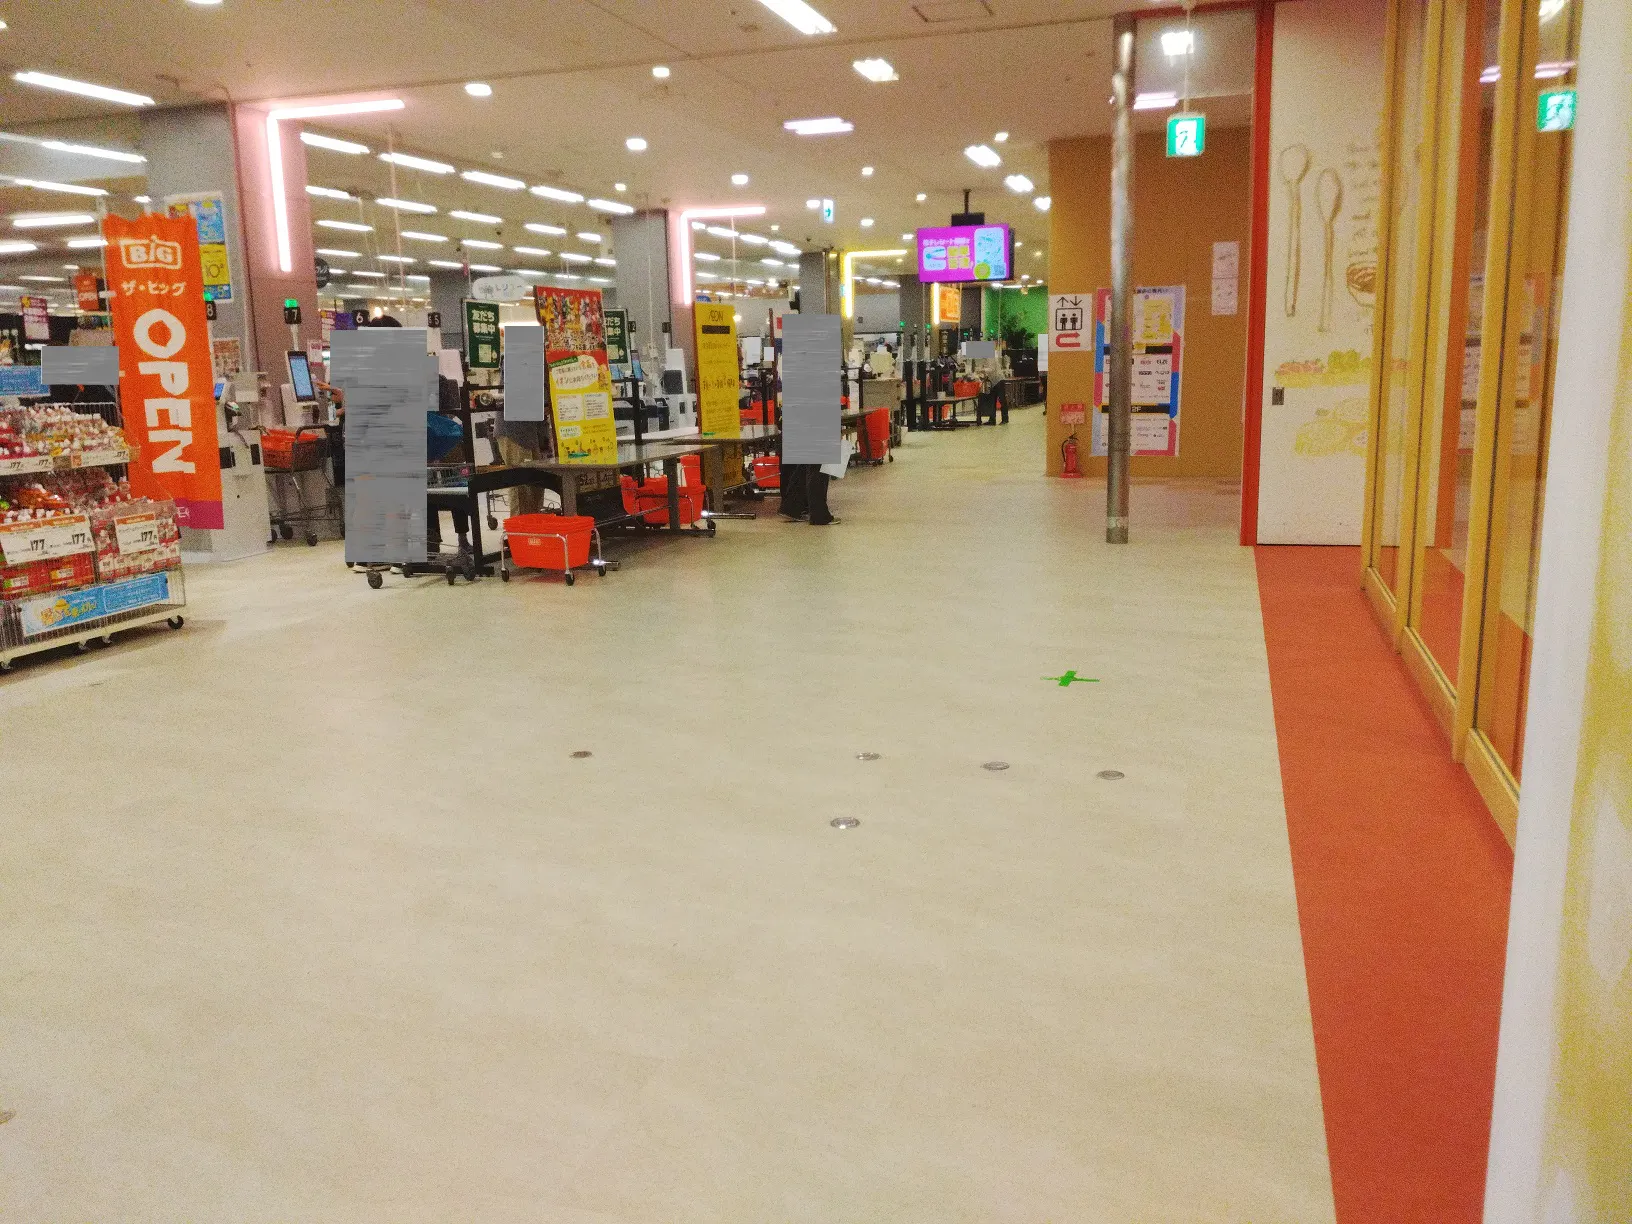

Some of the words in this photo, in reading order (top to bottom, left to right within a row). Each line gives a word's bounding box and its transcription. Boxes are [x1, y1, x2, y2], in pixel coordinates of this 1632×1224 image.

[129, 235, 173, 263] BIG
[121, 279, 187, 296] ザ・ビッグ
[206, 303, 213, 317] 8
[356, 312, 364, 324] 6
[133, 308, 196, 474] OPEN
[71, 532, 86, 544] 177
[140, 530, 153, 542] 177
[30, 538, 45, 551] 177
